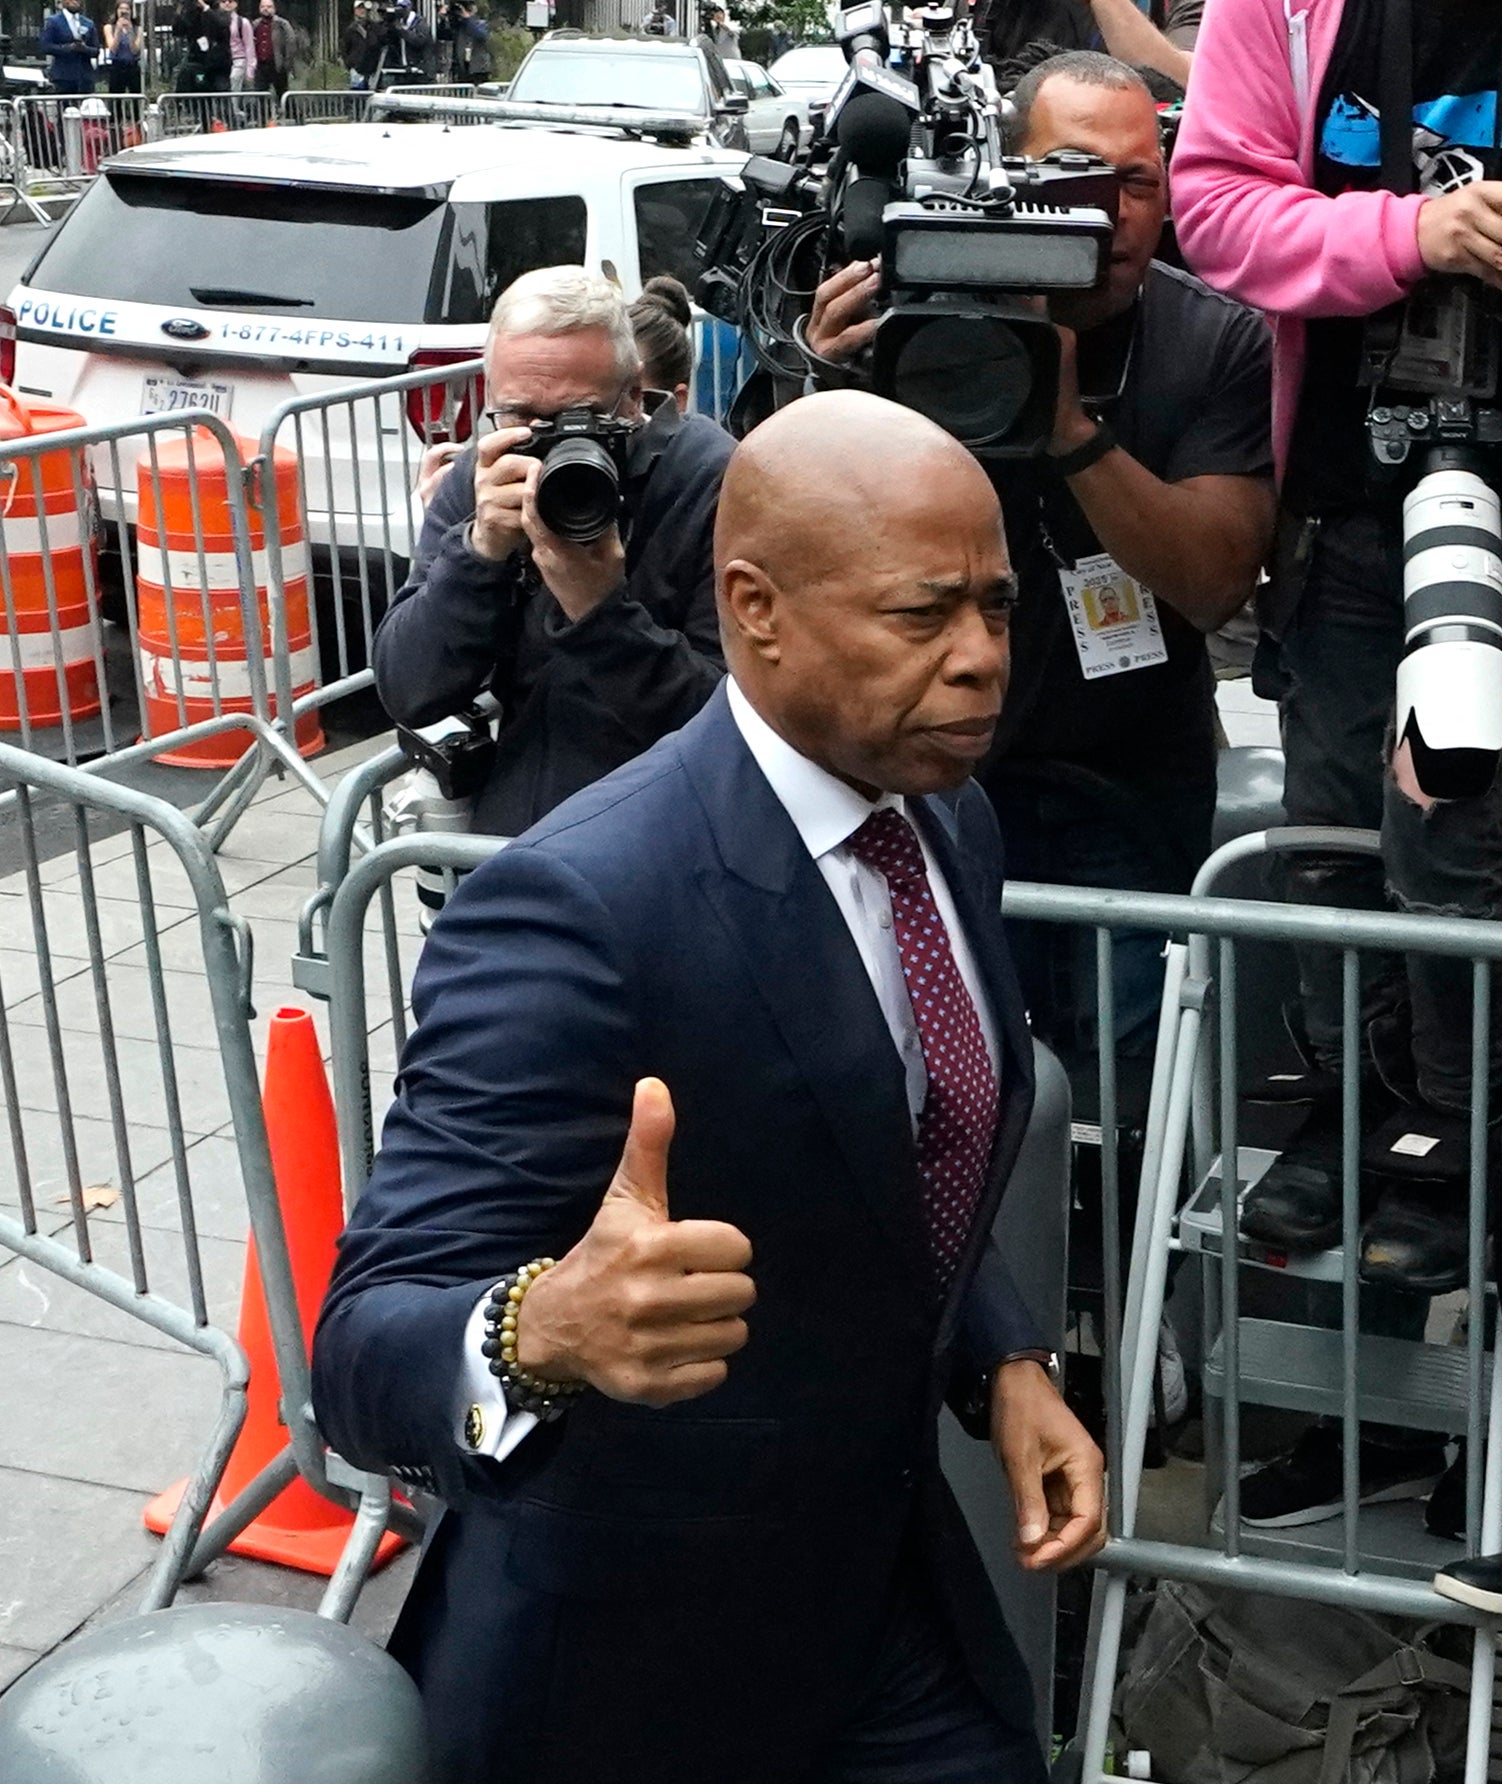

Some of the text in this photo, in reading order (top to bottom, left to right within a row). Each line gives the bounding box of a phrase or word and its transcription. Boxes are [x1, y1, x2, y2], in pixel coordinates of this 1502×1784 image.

[19, 300, 118, 335] POLICE
[220, 323, 404, 351] 1-877-4FPS-411
[1066, 586, 1088, 652] PRESS
